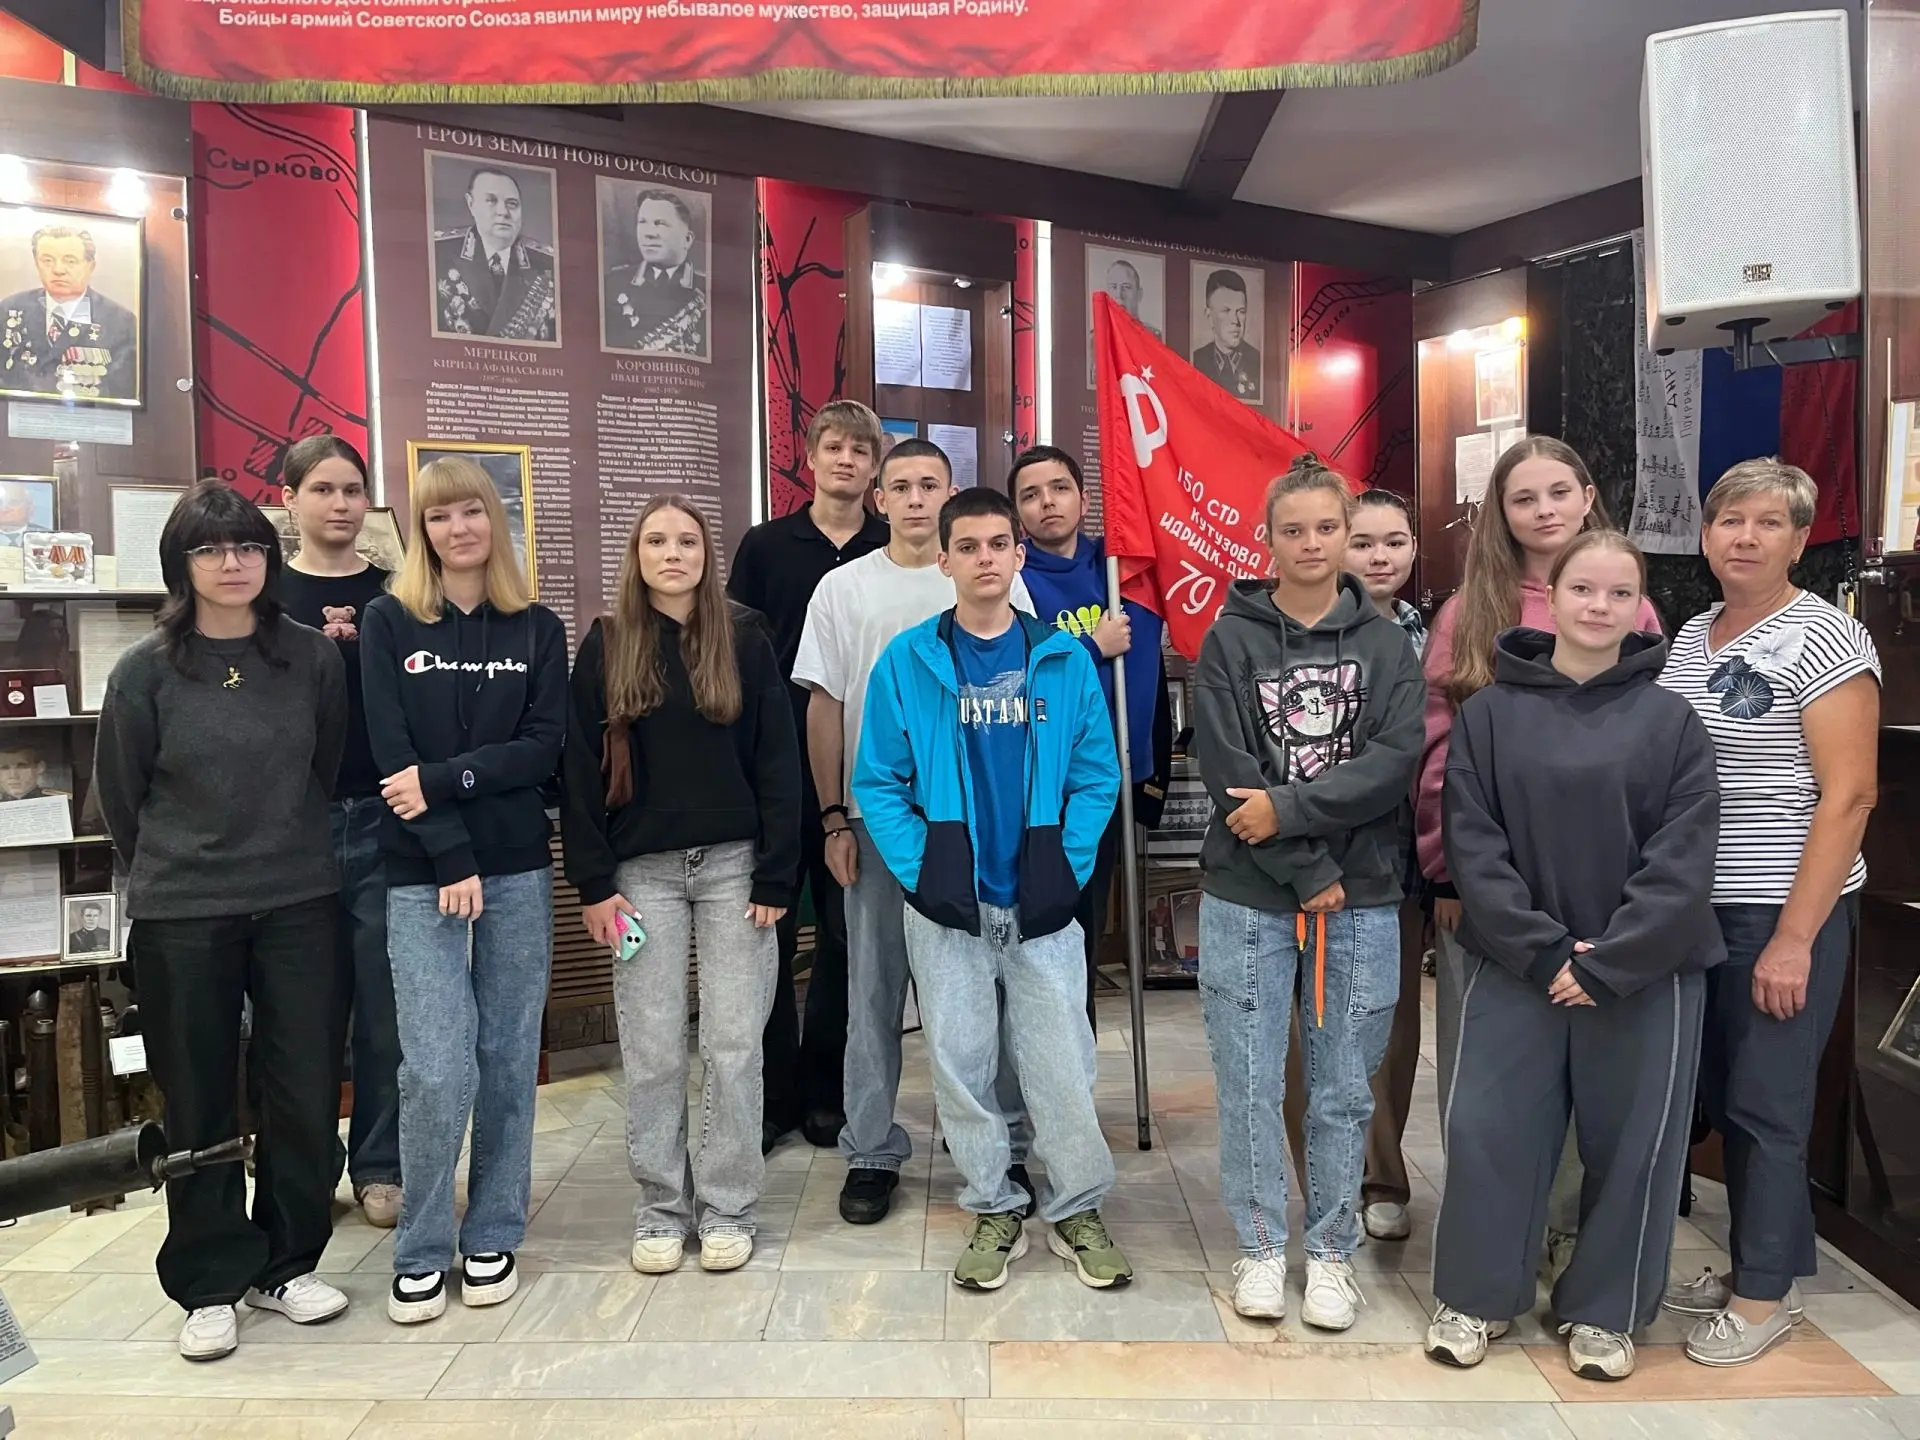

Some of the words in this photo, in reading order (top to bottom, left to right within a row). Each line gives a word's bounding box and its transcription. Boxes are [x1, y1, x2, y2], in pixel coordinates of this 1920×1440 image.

[219, 8, 286, 27] Бойцы
[291, 11, 352, 28] армий
[356, 11, 467, 28] Советского
[469, 10, 531, 27] Союза
[534, 9, 592, 25] явили
[596, 6, 643, 24] миру
[646, 0, 754, 19] небывалое
[758, 4, 858, 22] мужество,
[861, 2, 949, 19] защищая
[954, 0, 1028, 17] Родину.
[488, 135, 556, 160] ЗЕМЛИ
[206, 148, 340, 182] Сырково
[433, 359, 480, 371] КИРИЛЛ
[482, 362, 564, 377] АФАНАСЬЕВИЧ
[463, 346, 537, 363] МЕРЕЦКОВ
[616, 360, 700, 376] КОРОВНИКОВ
[611, 373, 639, 383] ИВАН
[1177, 466, 1204, 502] 150
[1207, 499, 1240, 526] СТР
[1159, 512, 1225, 569] ИДРИЦК.
[1190, 507, 1262, 569] КУТУЗОВА
[1165, 560, 1217, 614] 79
[960, 697, 1029, 724] USTAN
